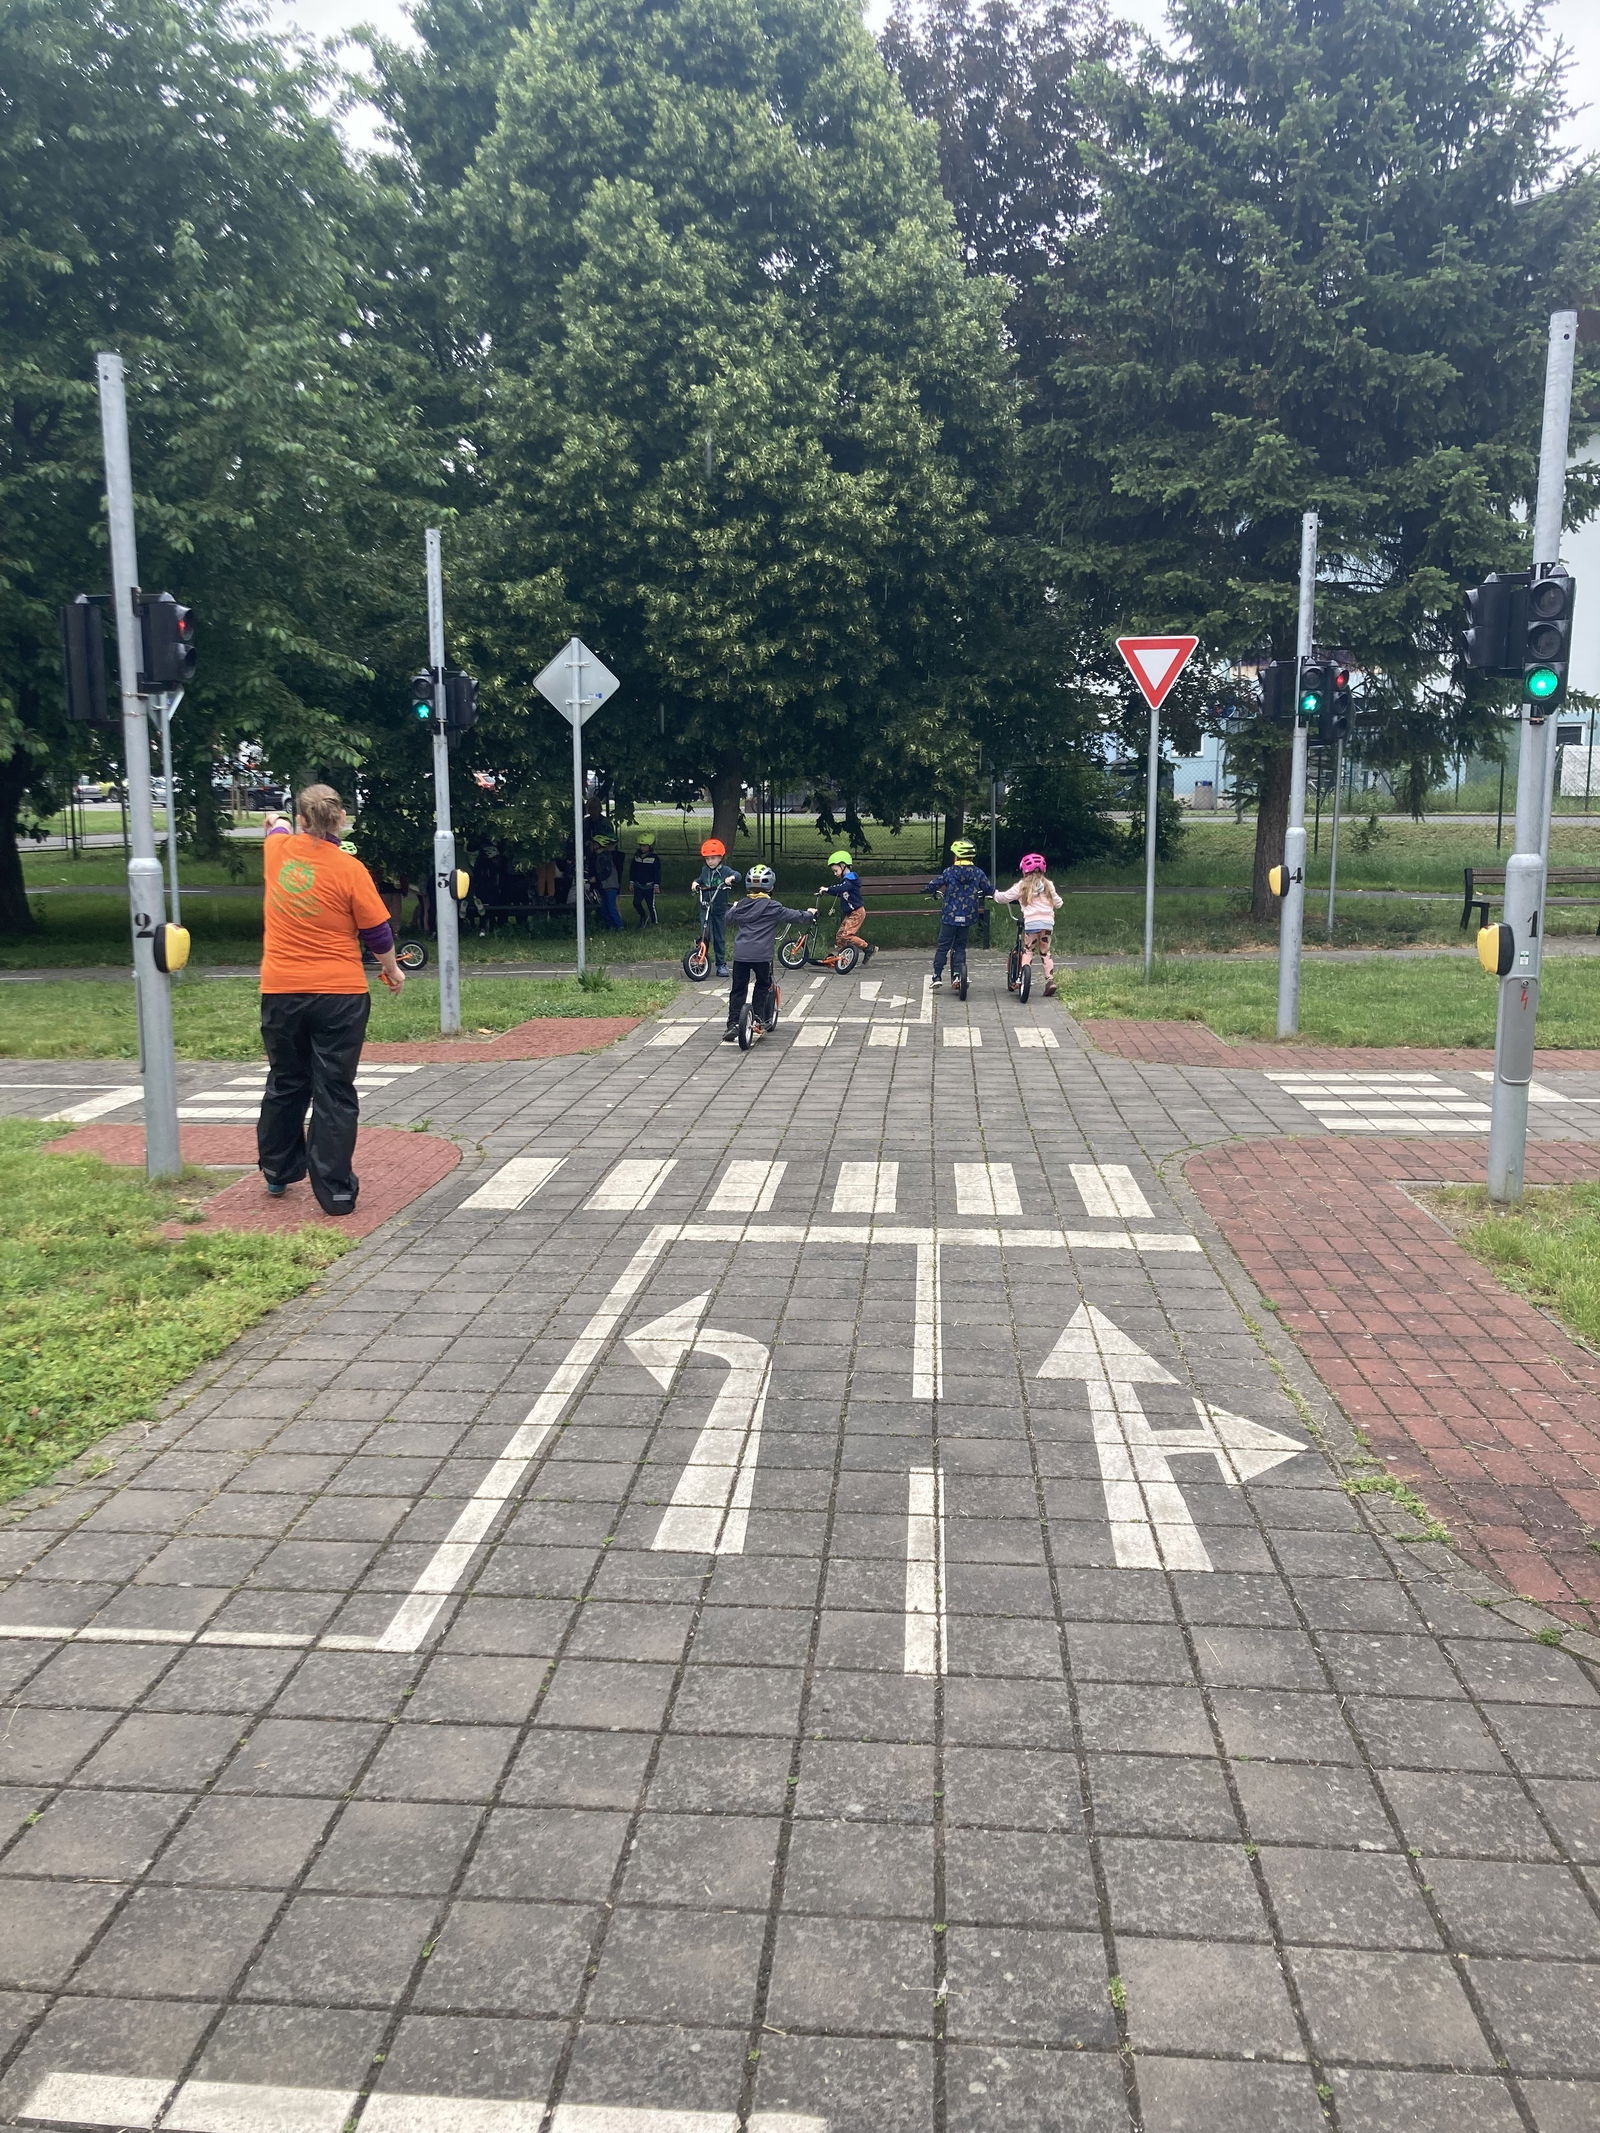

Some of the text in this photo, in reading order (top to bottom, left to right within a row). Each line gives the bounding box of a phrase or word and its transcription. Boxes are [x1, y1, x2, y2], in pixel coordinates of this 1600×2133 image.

[1288, 867, 1303, 883] 4
[135, 912, 154, 938] 2
[1527, 911, 1538, 937] 1
